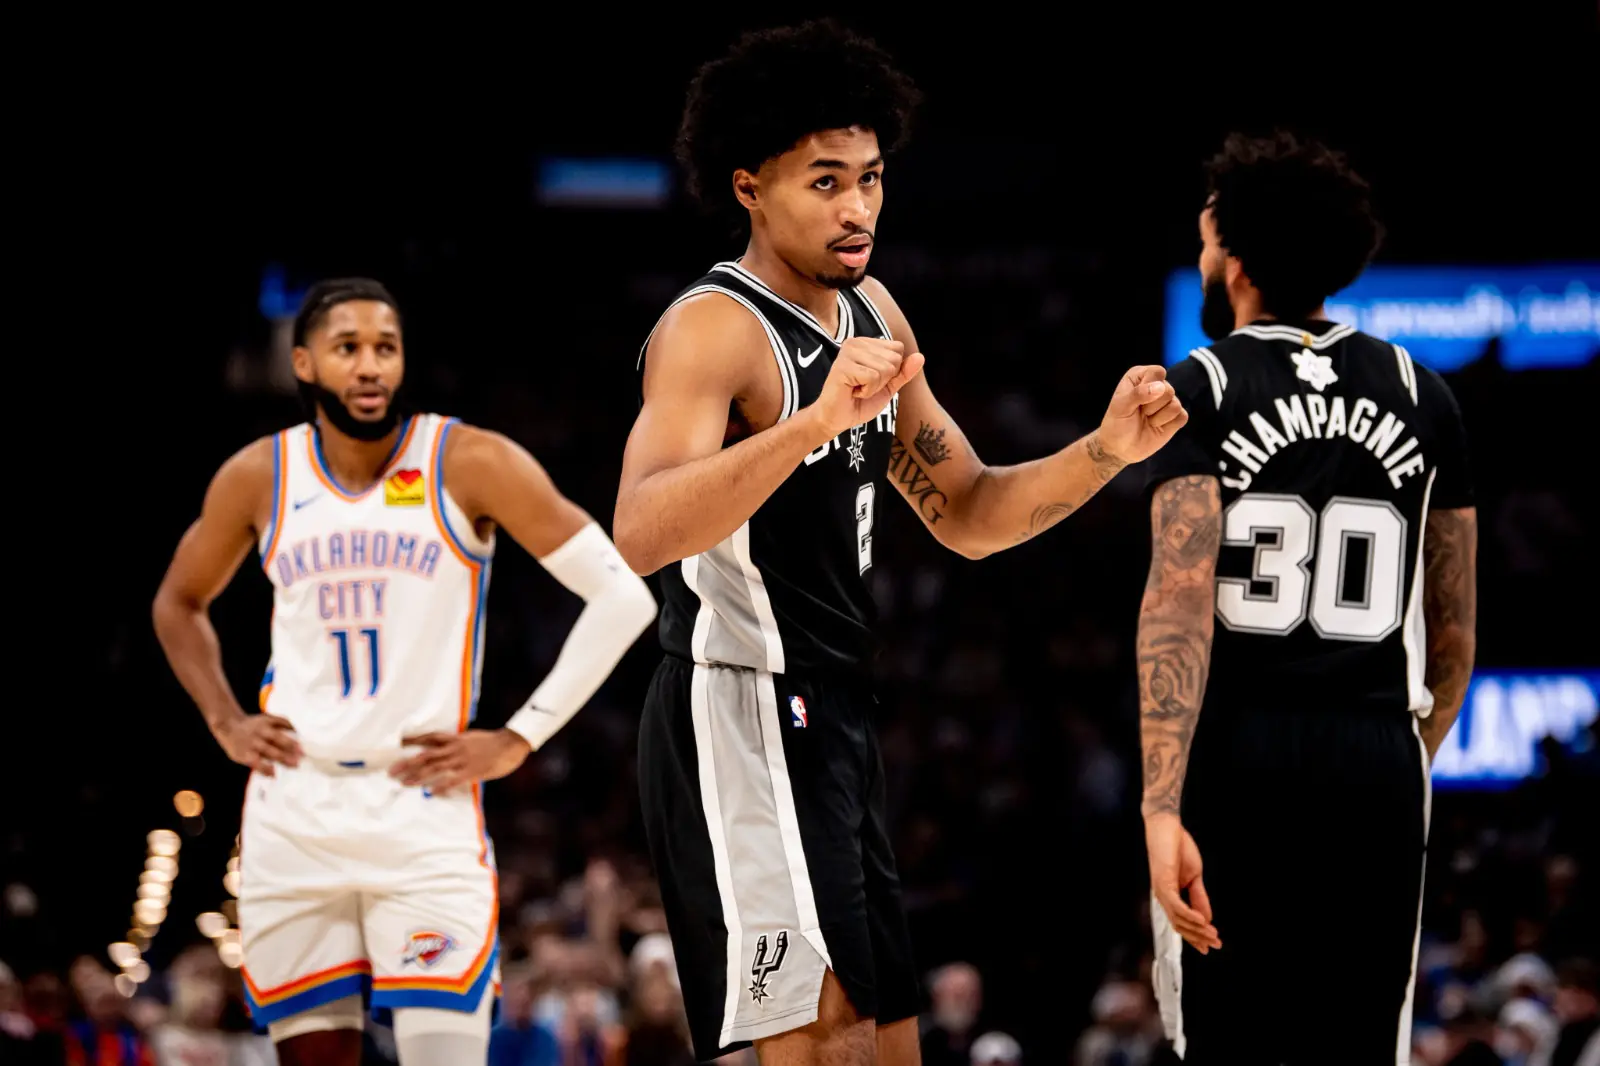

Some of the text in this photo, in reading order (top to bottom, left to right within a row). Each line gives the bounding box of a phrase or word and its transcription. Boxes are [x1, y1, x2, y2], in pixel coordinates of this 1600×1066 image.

[1218, 394, 1425, 491] CHAMPAGNIE
[276, 530, 443, 588] OKLAHOMA
[855, 481, 876, 577] 2
[1214, 492, 1408, 643] 30
[318, 579, 389, 620] CITY
[329, 625, 383, 699] 11
